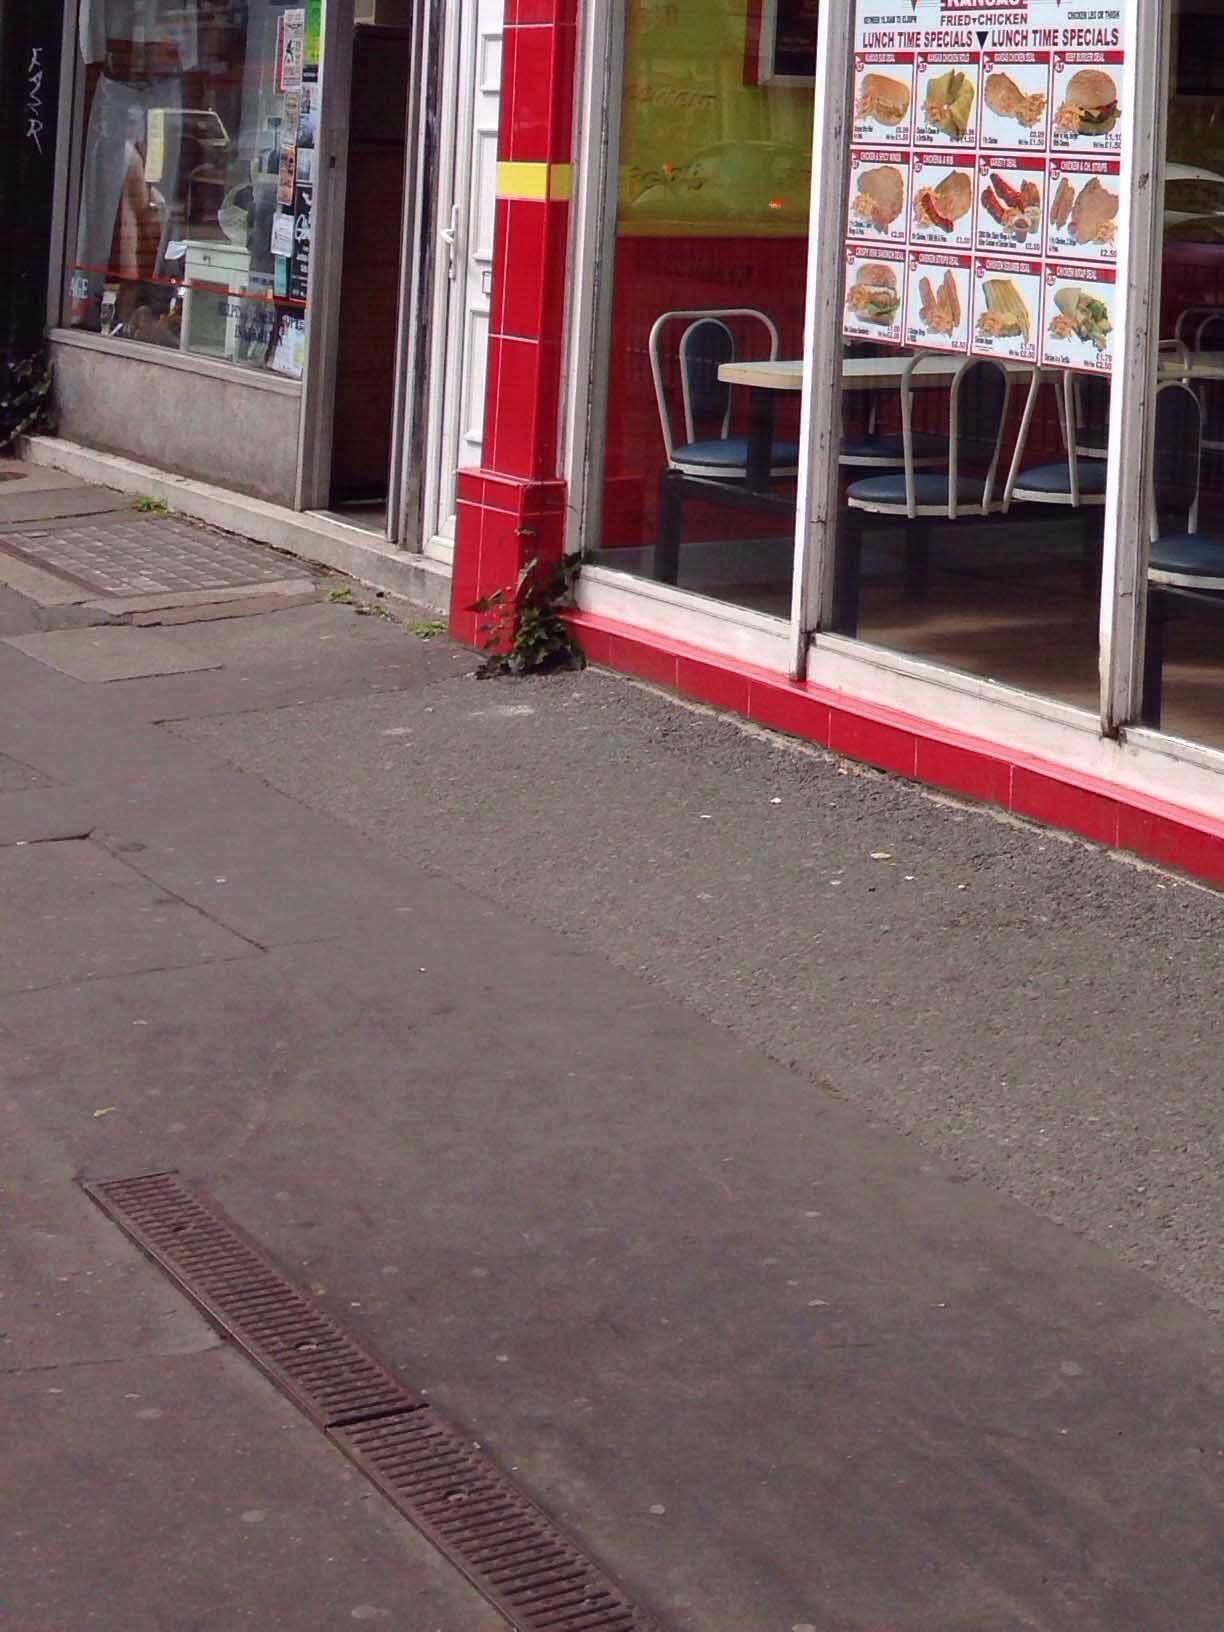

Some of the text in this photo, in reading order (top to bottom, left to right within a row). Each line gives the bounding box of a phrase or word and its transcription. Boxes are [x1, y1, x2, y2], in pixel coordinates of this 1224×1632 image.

[940, 13, 1029, 27] FRIED CHICKEN
[862, 30, 973, 49] LUNCH TIME SPECIALS
[991, 27, 1120, 48] LUNCH TIME SPECIALS
